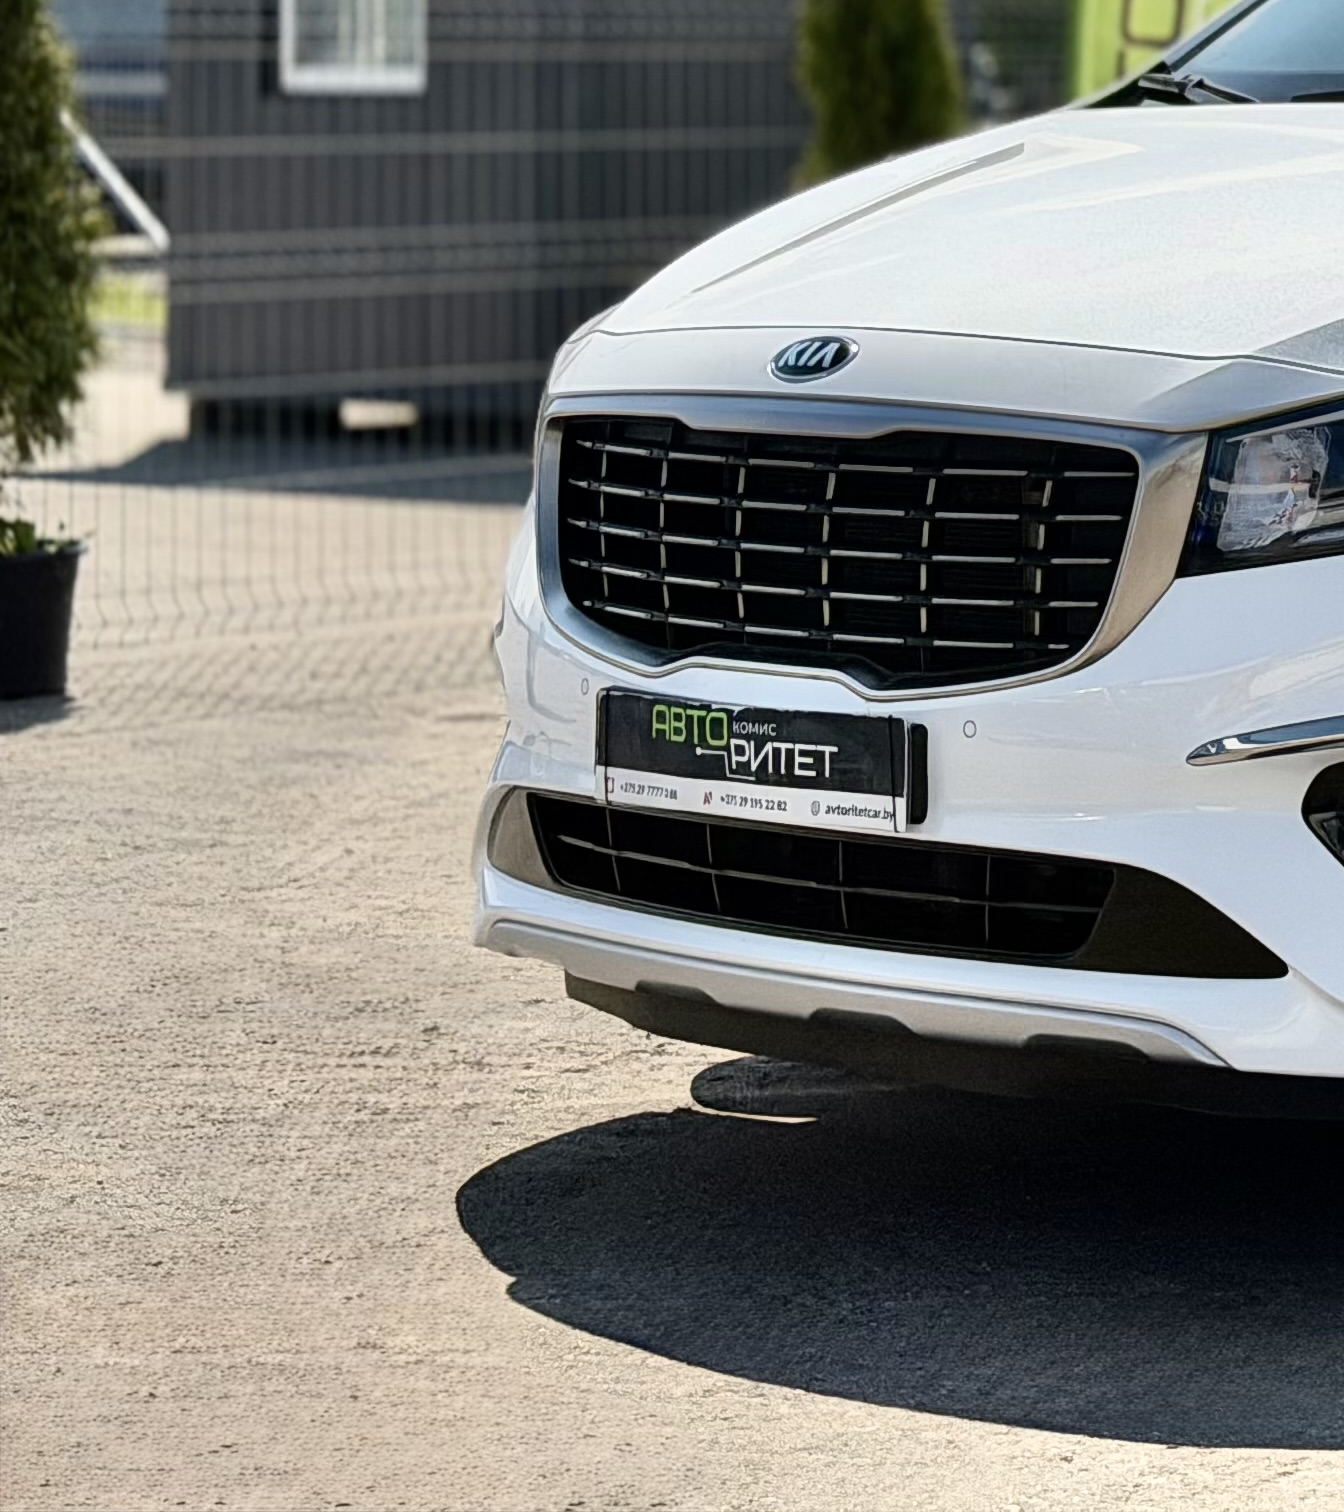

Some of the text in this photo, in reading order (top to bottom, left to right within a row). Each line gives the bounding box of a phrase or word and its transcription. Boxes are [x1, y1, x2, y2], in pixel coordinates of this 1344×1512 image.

[777, 341, 841, 368] KIA
[652, 704, 728, 747] АВТО
[730, 738, 839, 779] РИТЕТ
